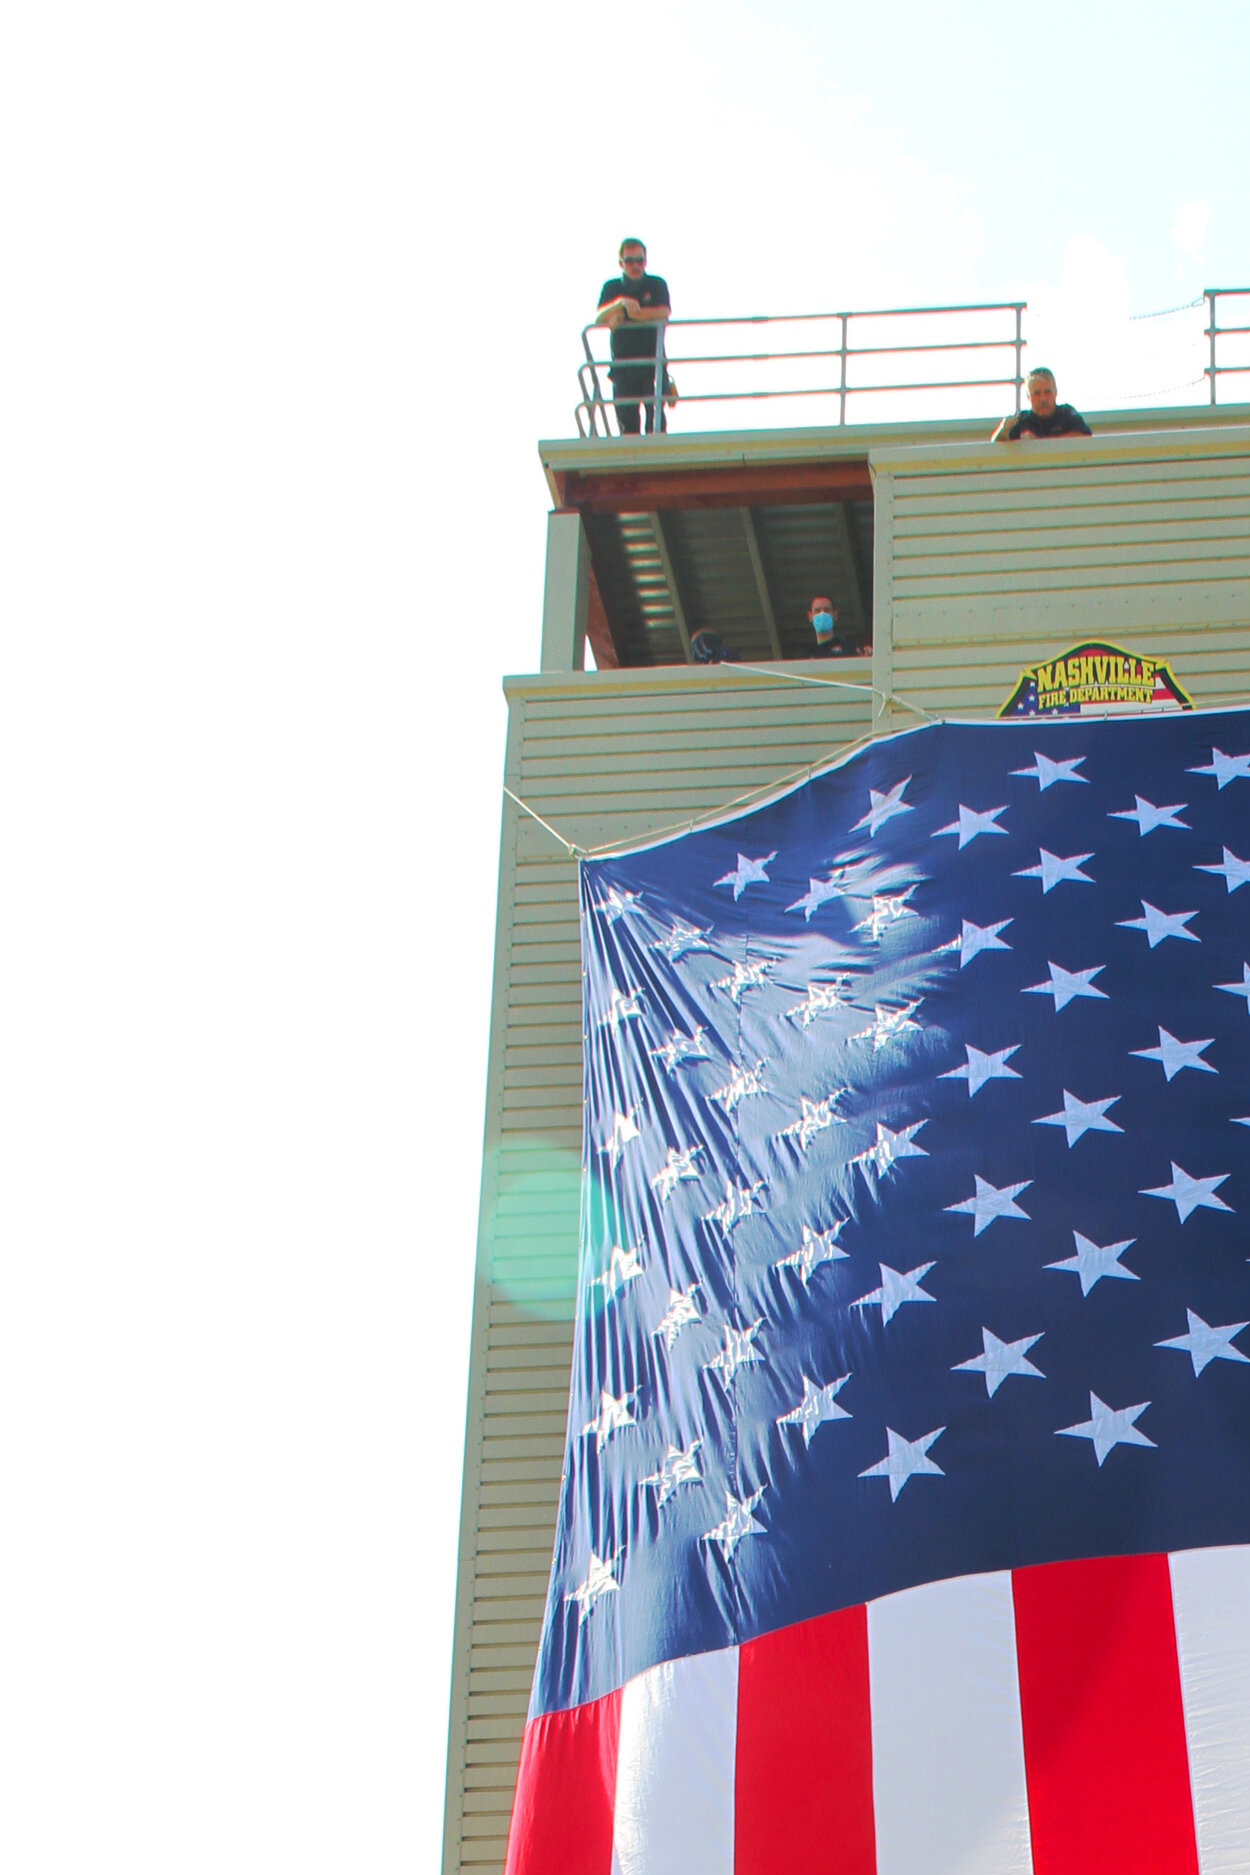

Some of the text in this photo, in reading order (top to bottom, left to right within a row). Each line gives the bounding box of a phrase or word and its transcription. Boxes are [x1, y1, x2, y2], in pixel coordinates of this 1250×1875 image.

[1037, 655, 1154, 693] NASHVILLE
[1038, 687, 1153, 709] FIRE DEPARTMENT
